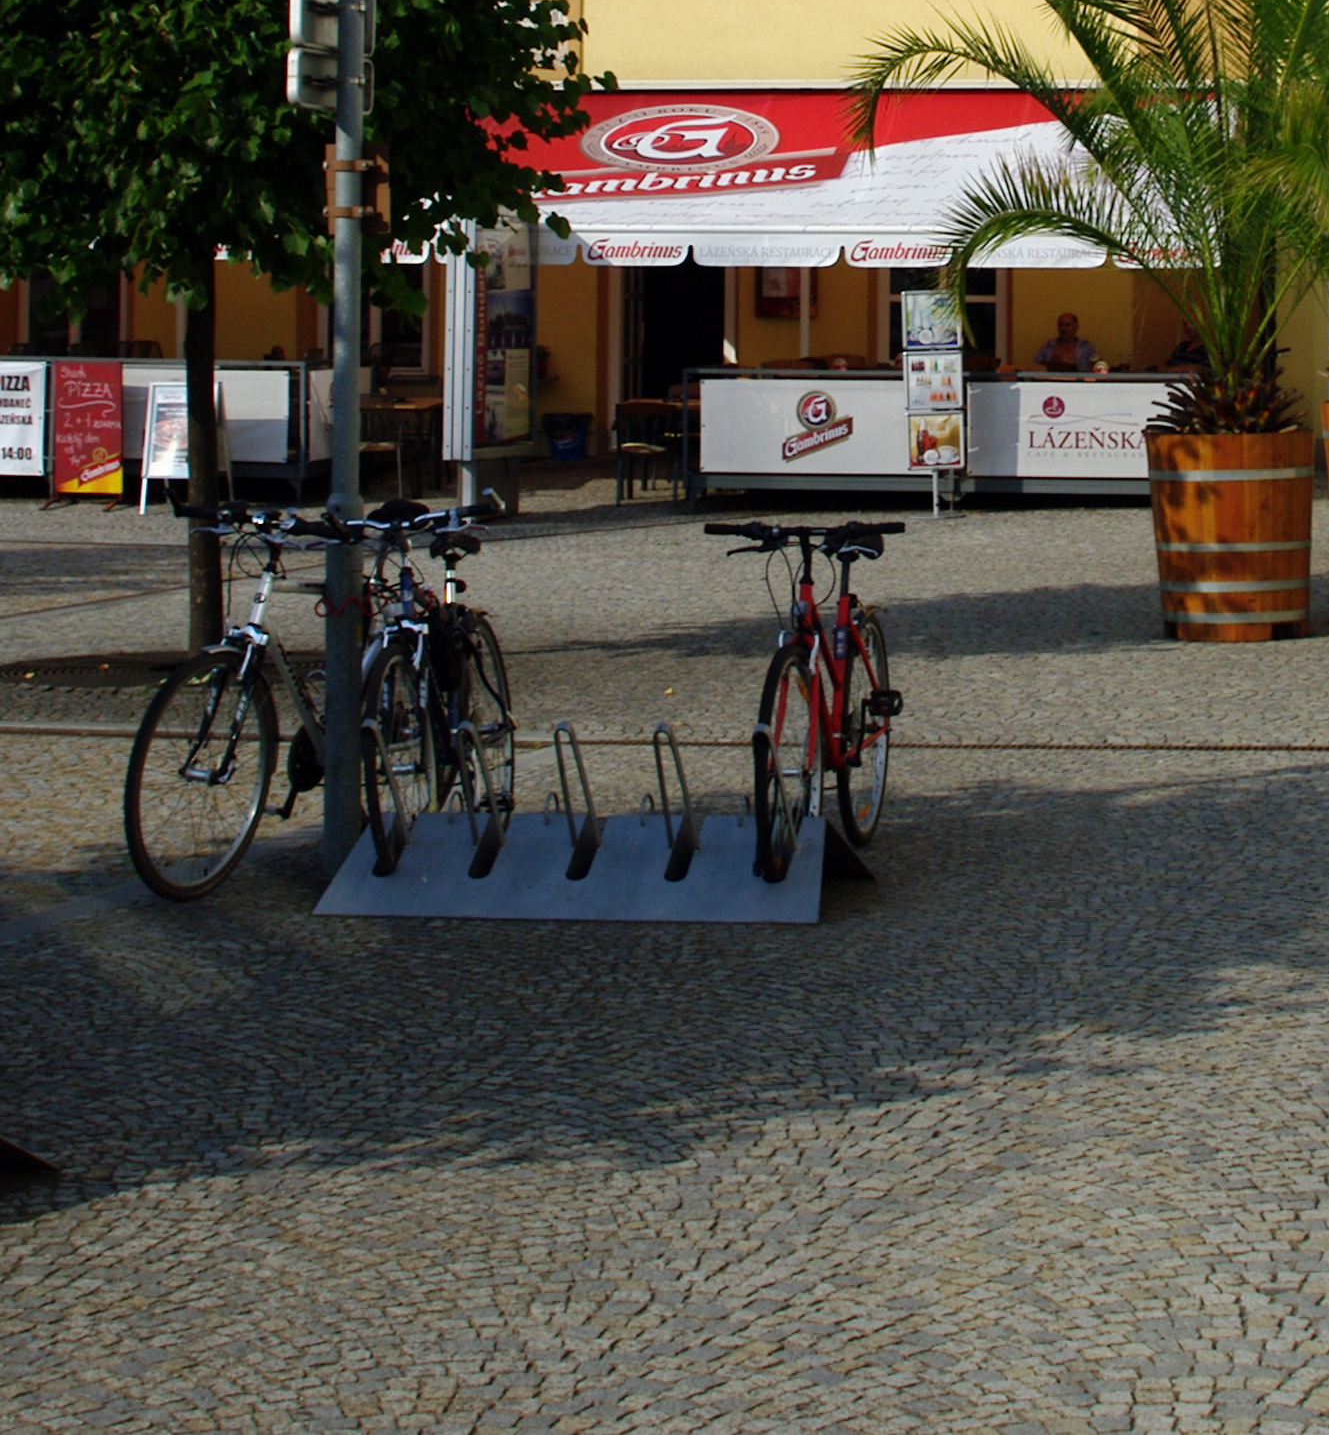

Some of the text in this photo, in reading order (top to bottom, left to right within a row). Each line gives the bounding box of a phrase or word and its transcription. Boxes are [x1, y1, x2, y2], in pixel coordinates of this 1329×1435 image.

[531, 164, 816, 199] ambrinus
[587, 238, 683, 261] Gambrinus
[699, 244, 836, 258] LÁZEŇSKÁ RESTAURACE
[784, 422, 849, 458] Gambrinus
[1, 447, 33, 461] 14:00
[1077, 451, 1145, 459] RESTAURAN
